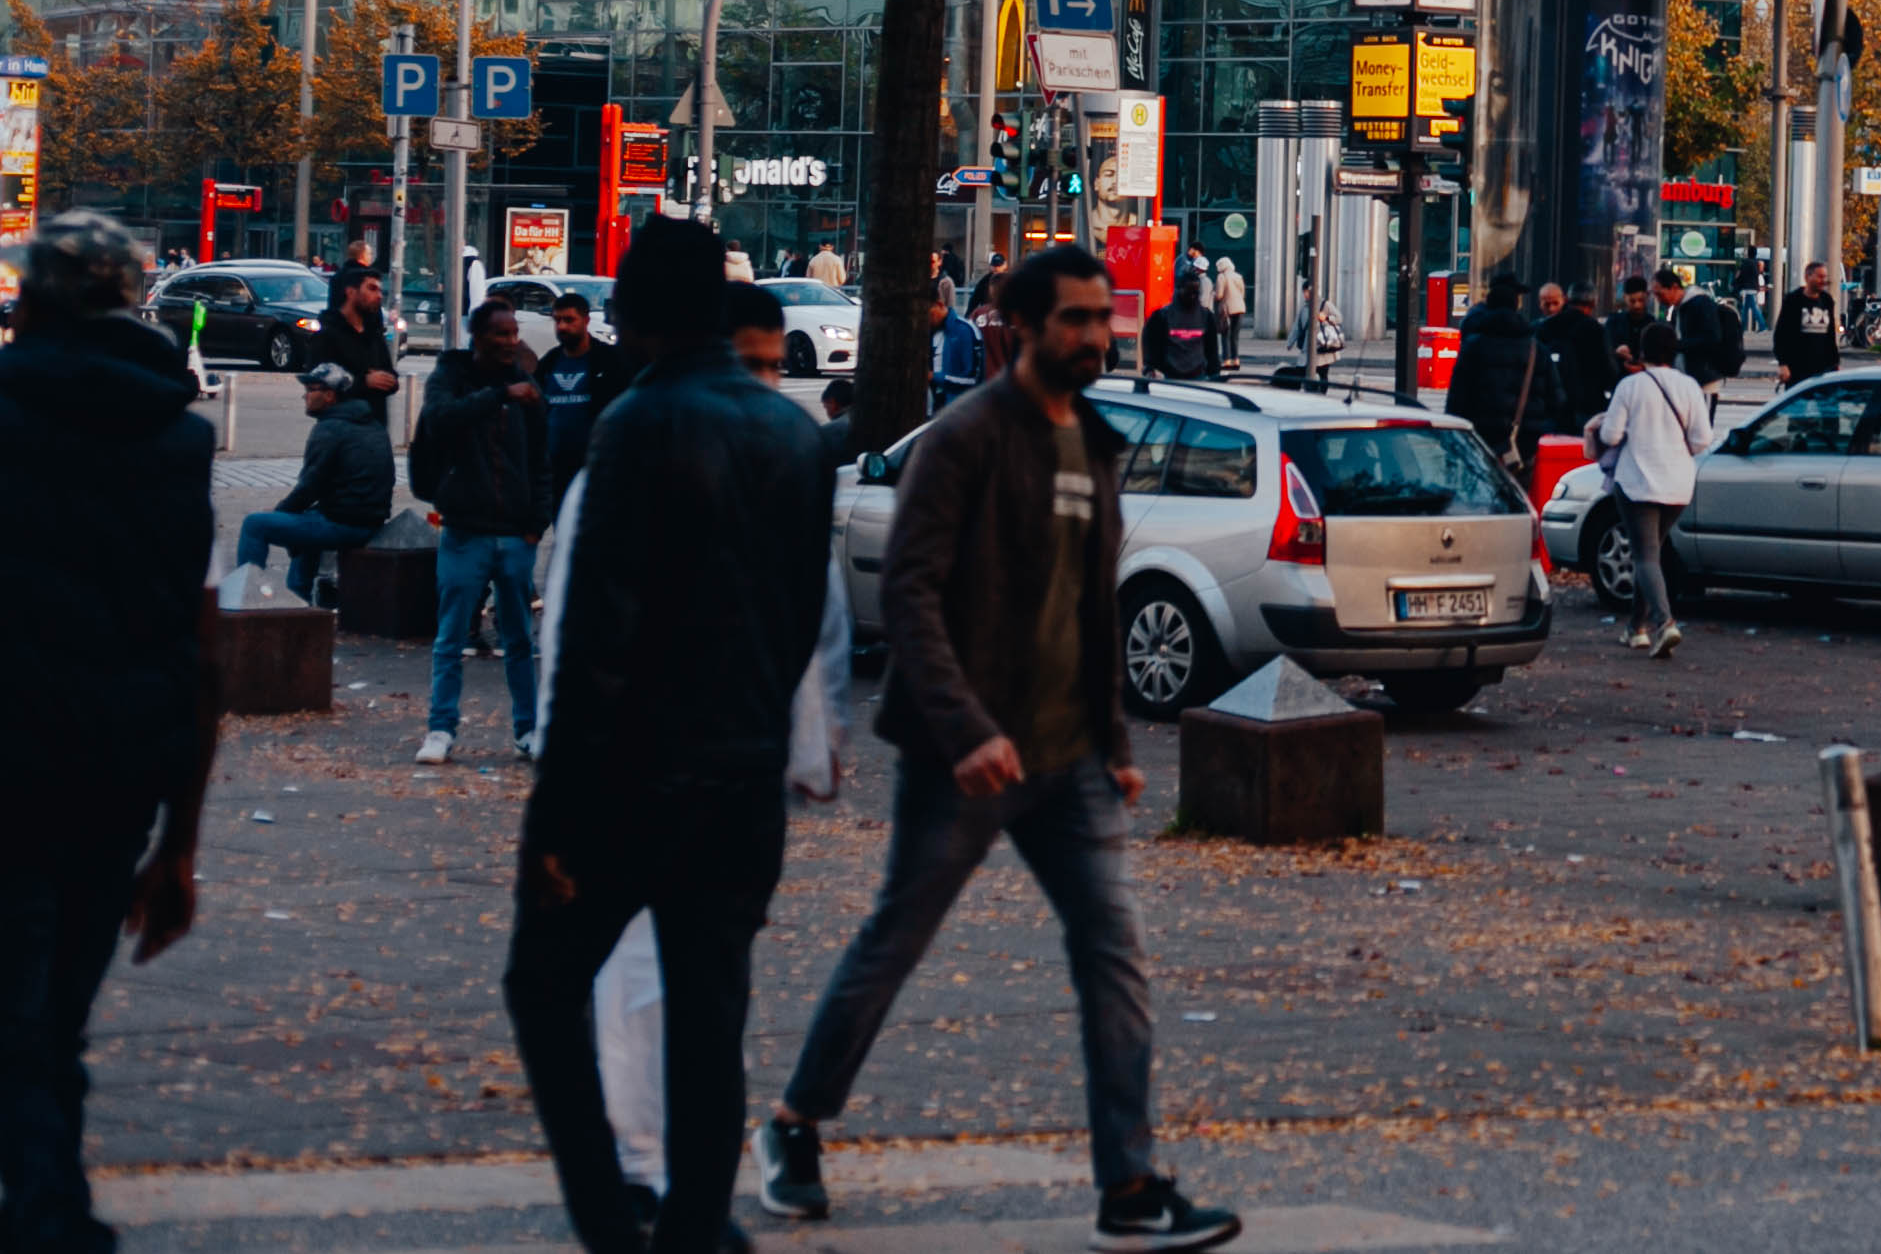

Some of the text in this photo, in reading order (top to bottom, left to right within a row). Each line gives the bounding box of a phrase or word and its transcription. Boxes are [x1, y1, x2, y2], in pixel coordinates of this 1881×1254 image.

[1069, 48, 1088, 60] mit
[1419, 51, 1455, 70] Geld-
[1355, 60, 1403, 76] Money-
[396, 63, 425, 107] P
[486, 65, 516, 109] P
[1419, 71, 1470, 87] wechsel
[1355, 81, 1405, 97] Transfer
[1660, 177, 1734, 209] amburg
[1449, 593, 1484, 613] 2451
